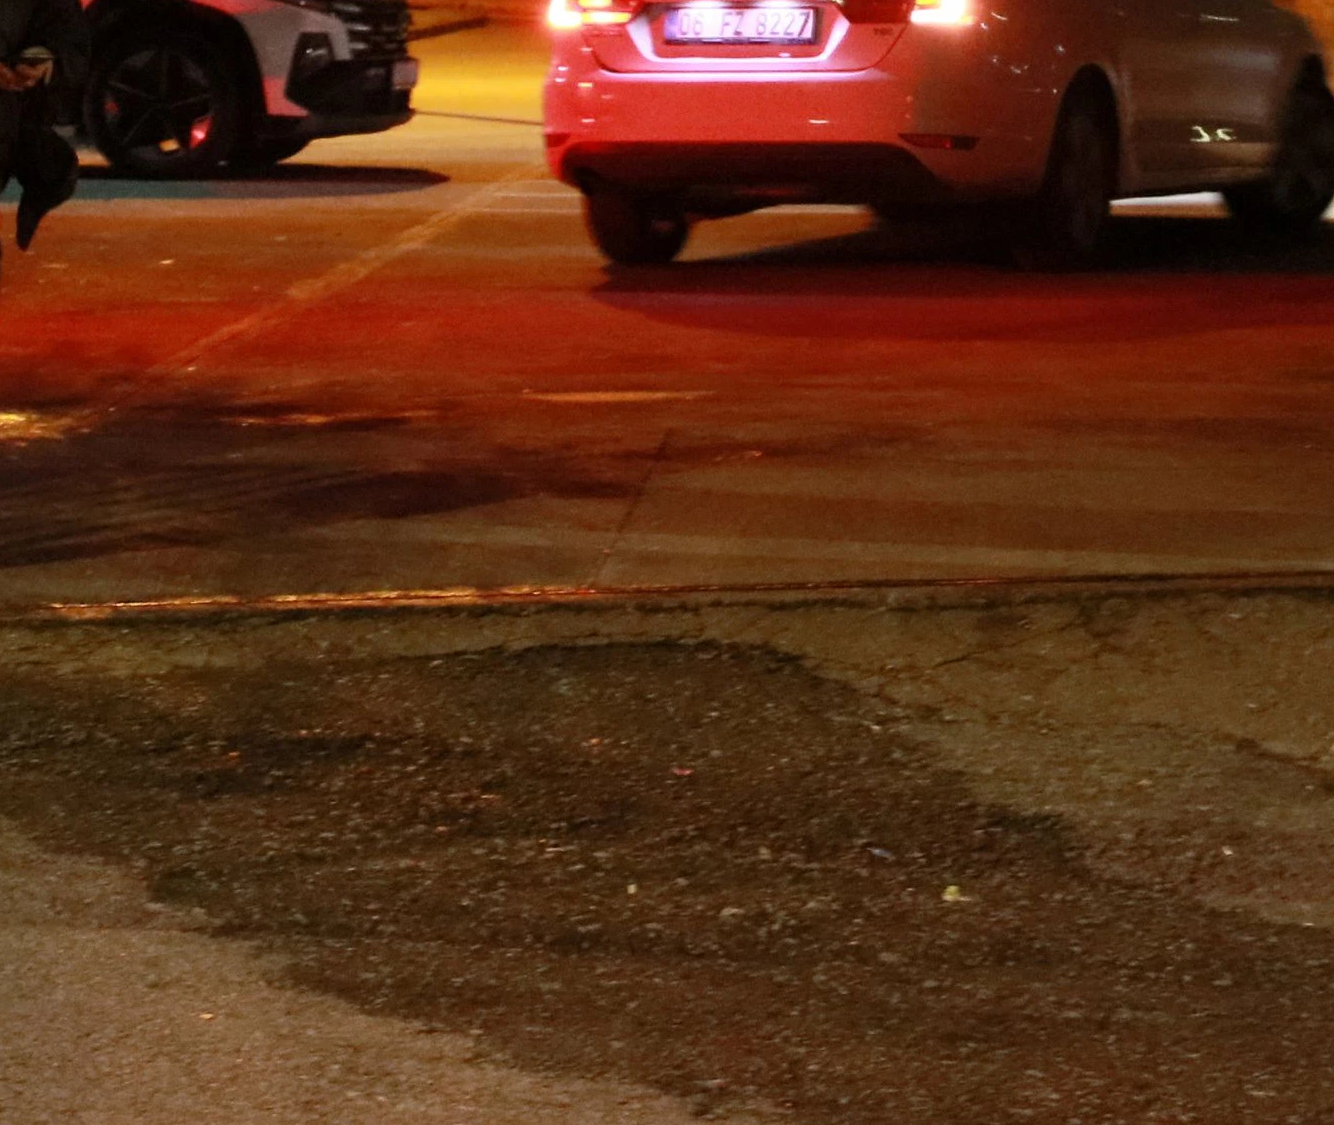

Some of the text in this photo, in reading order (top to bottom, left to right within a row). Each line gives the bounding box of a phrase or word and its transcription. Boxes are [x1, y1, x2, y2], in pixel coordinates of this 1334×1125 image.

[680, 11, 810, 36] 06 FZ 8227
